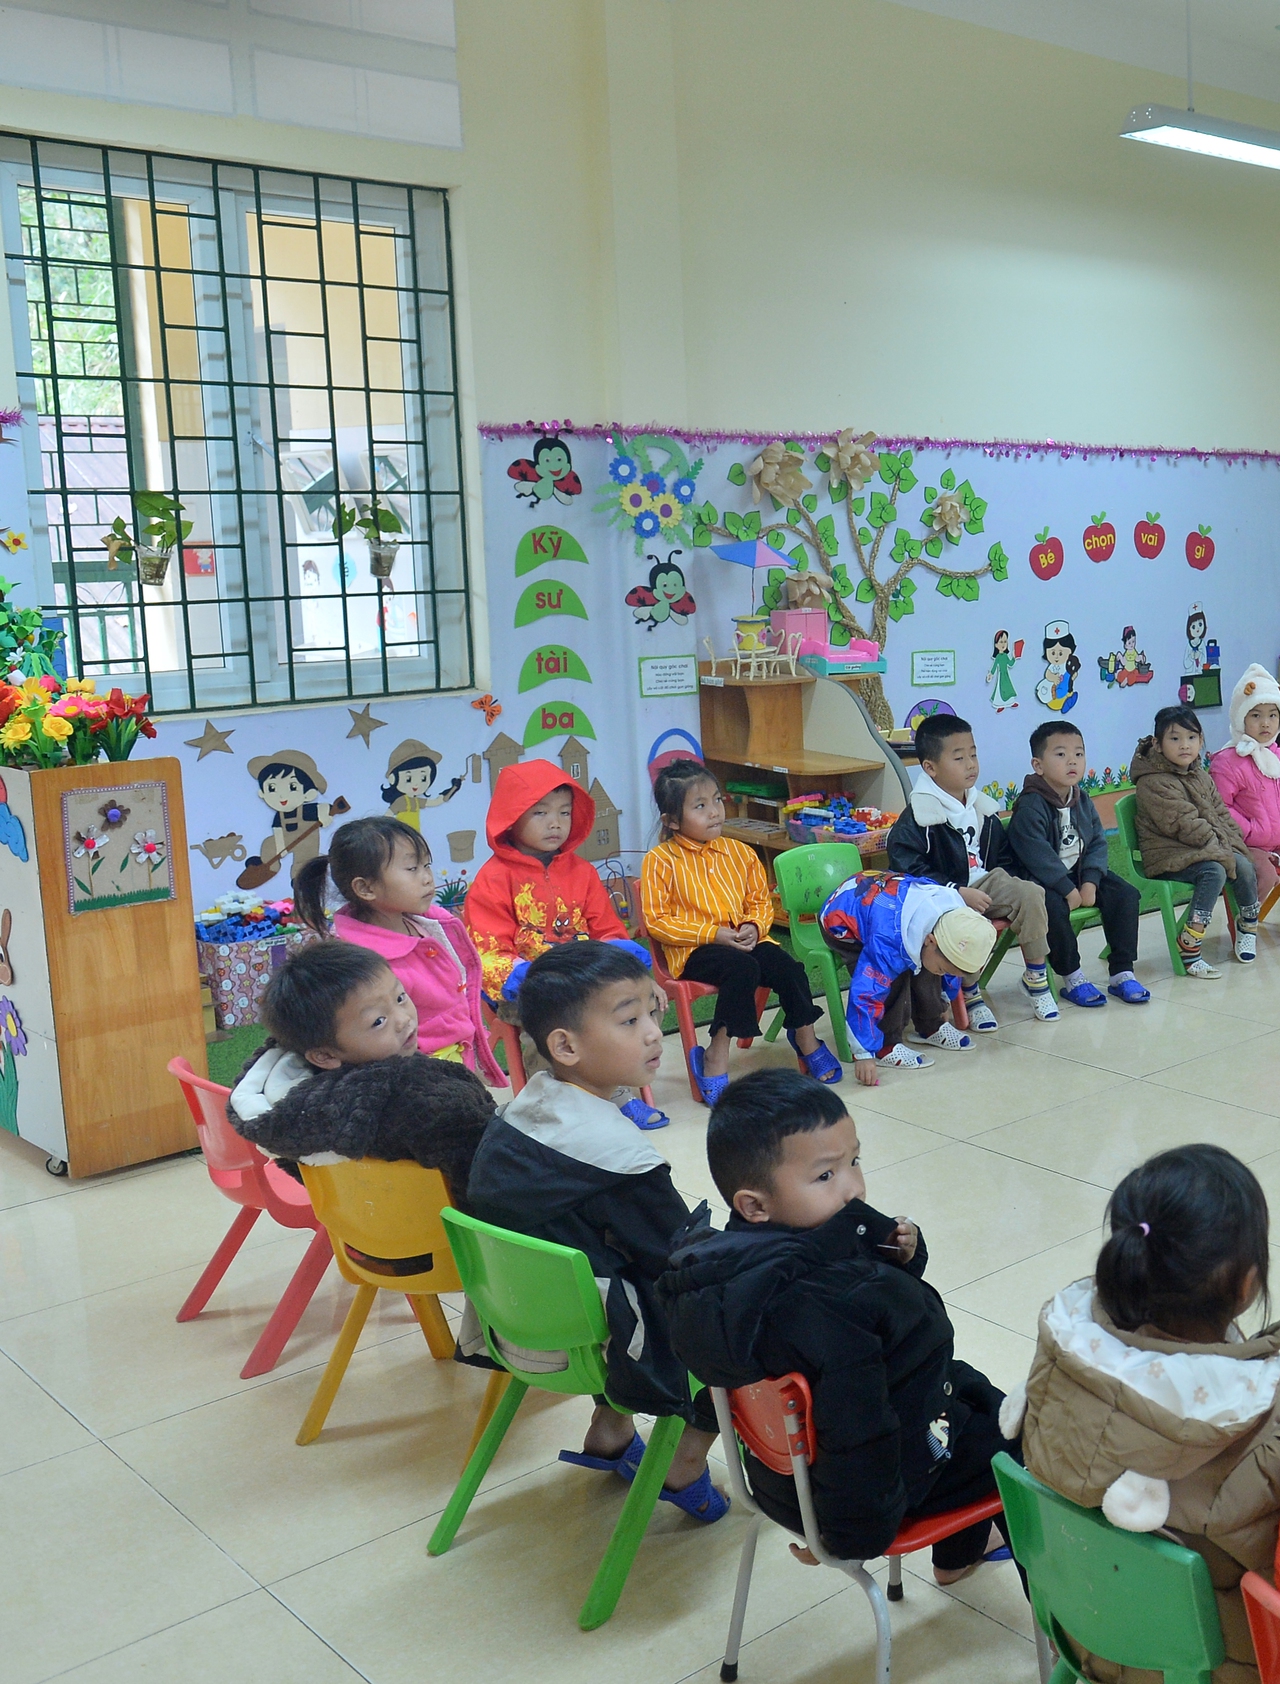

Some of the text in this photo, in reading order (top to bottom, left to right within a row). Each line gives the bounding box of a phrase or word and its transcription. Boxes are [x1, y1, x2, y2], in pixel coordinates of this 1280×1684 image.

[531, 531, 563, 558] Kỹ
[1084, 532, 1115, 550] chọn
[1141, 533, 1158, 547] vai
[1038, 549, 1056, 568] Bé
[535, 589, 563, 609] sư
[536, 651, 568, 674] tài
[541, 708, 574, 729] ba
